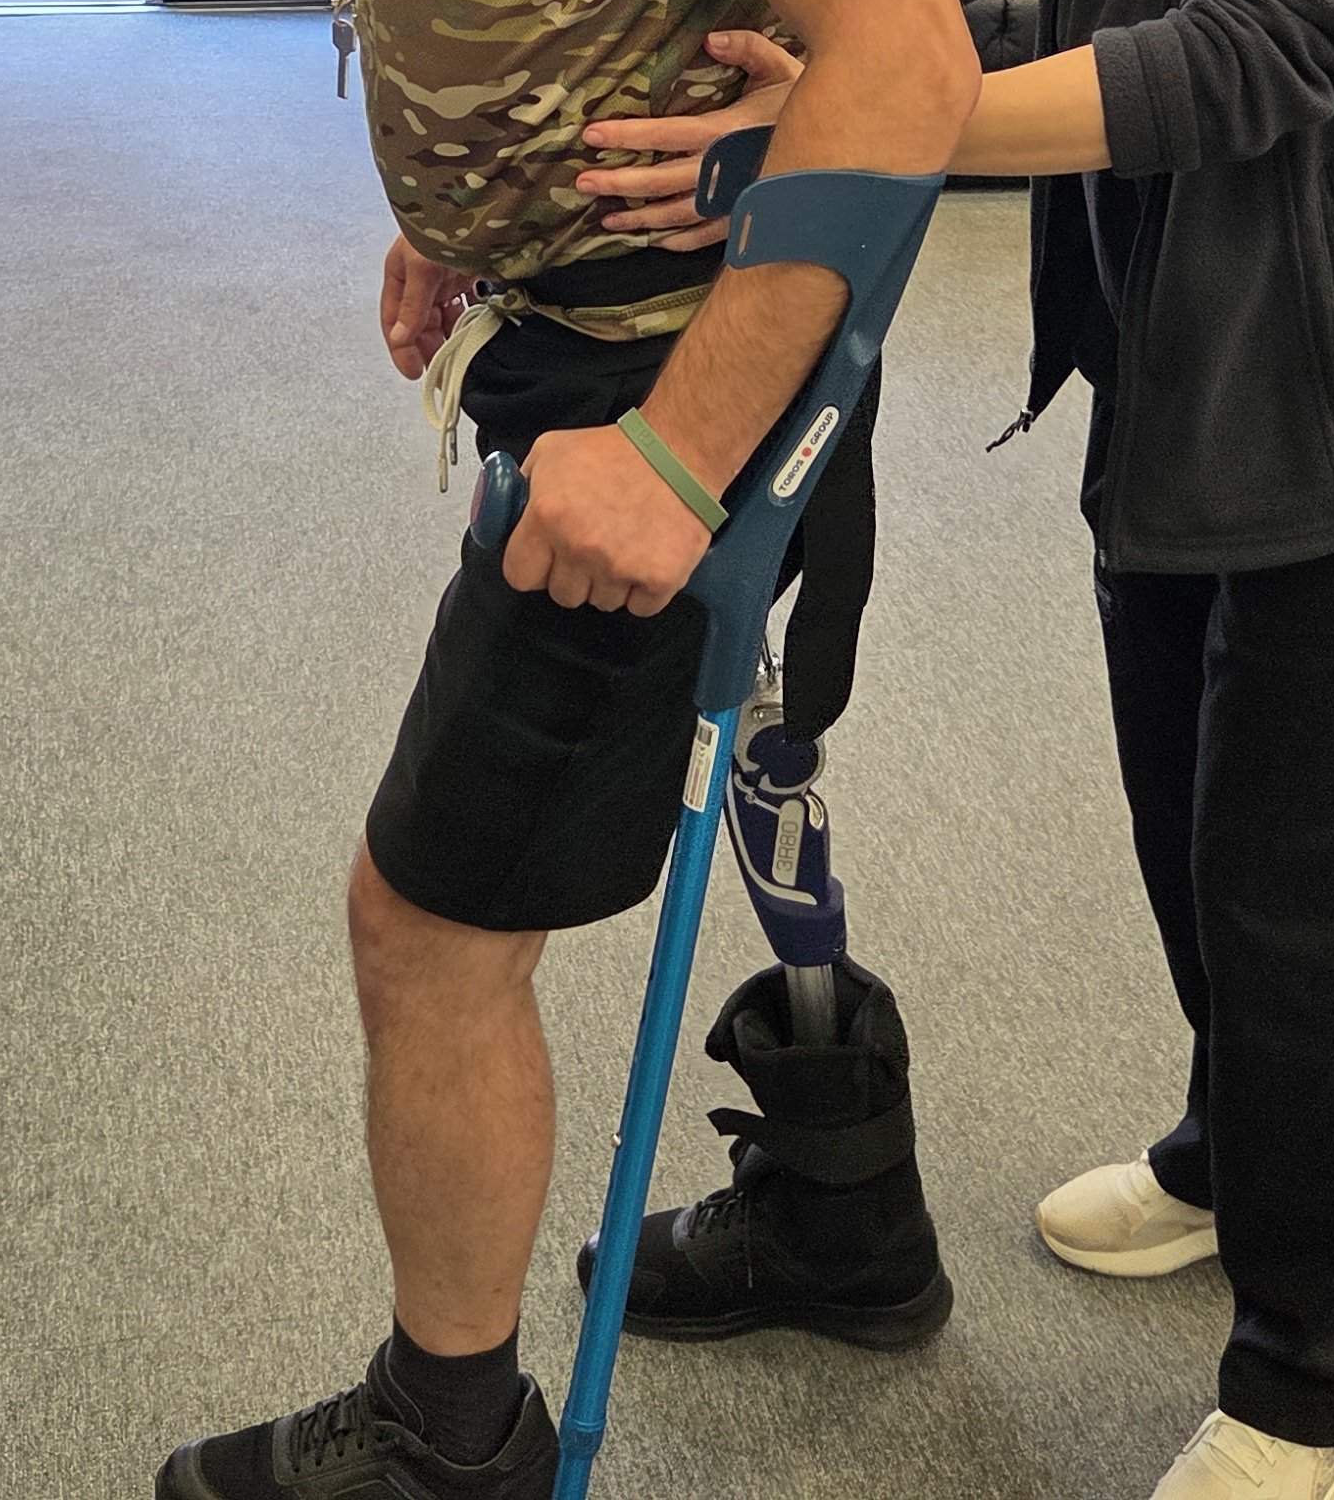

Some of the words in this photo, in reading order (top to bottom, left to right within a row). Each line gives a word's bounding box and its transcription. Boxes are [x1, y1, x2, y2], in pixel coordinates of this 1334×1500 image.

[778, 459, 804, 492] TOROS
[810, 412, 833, 445] GROUP
[776, 820, 799, 872] 3R80
